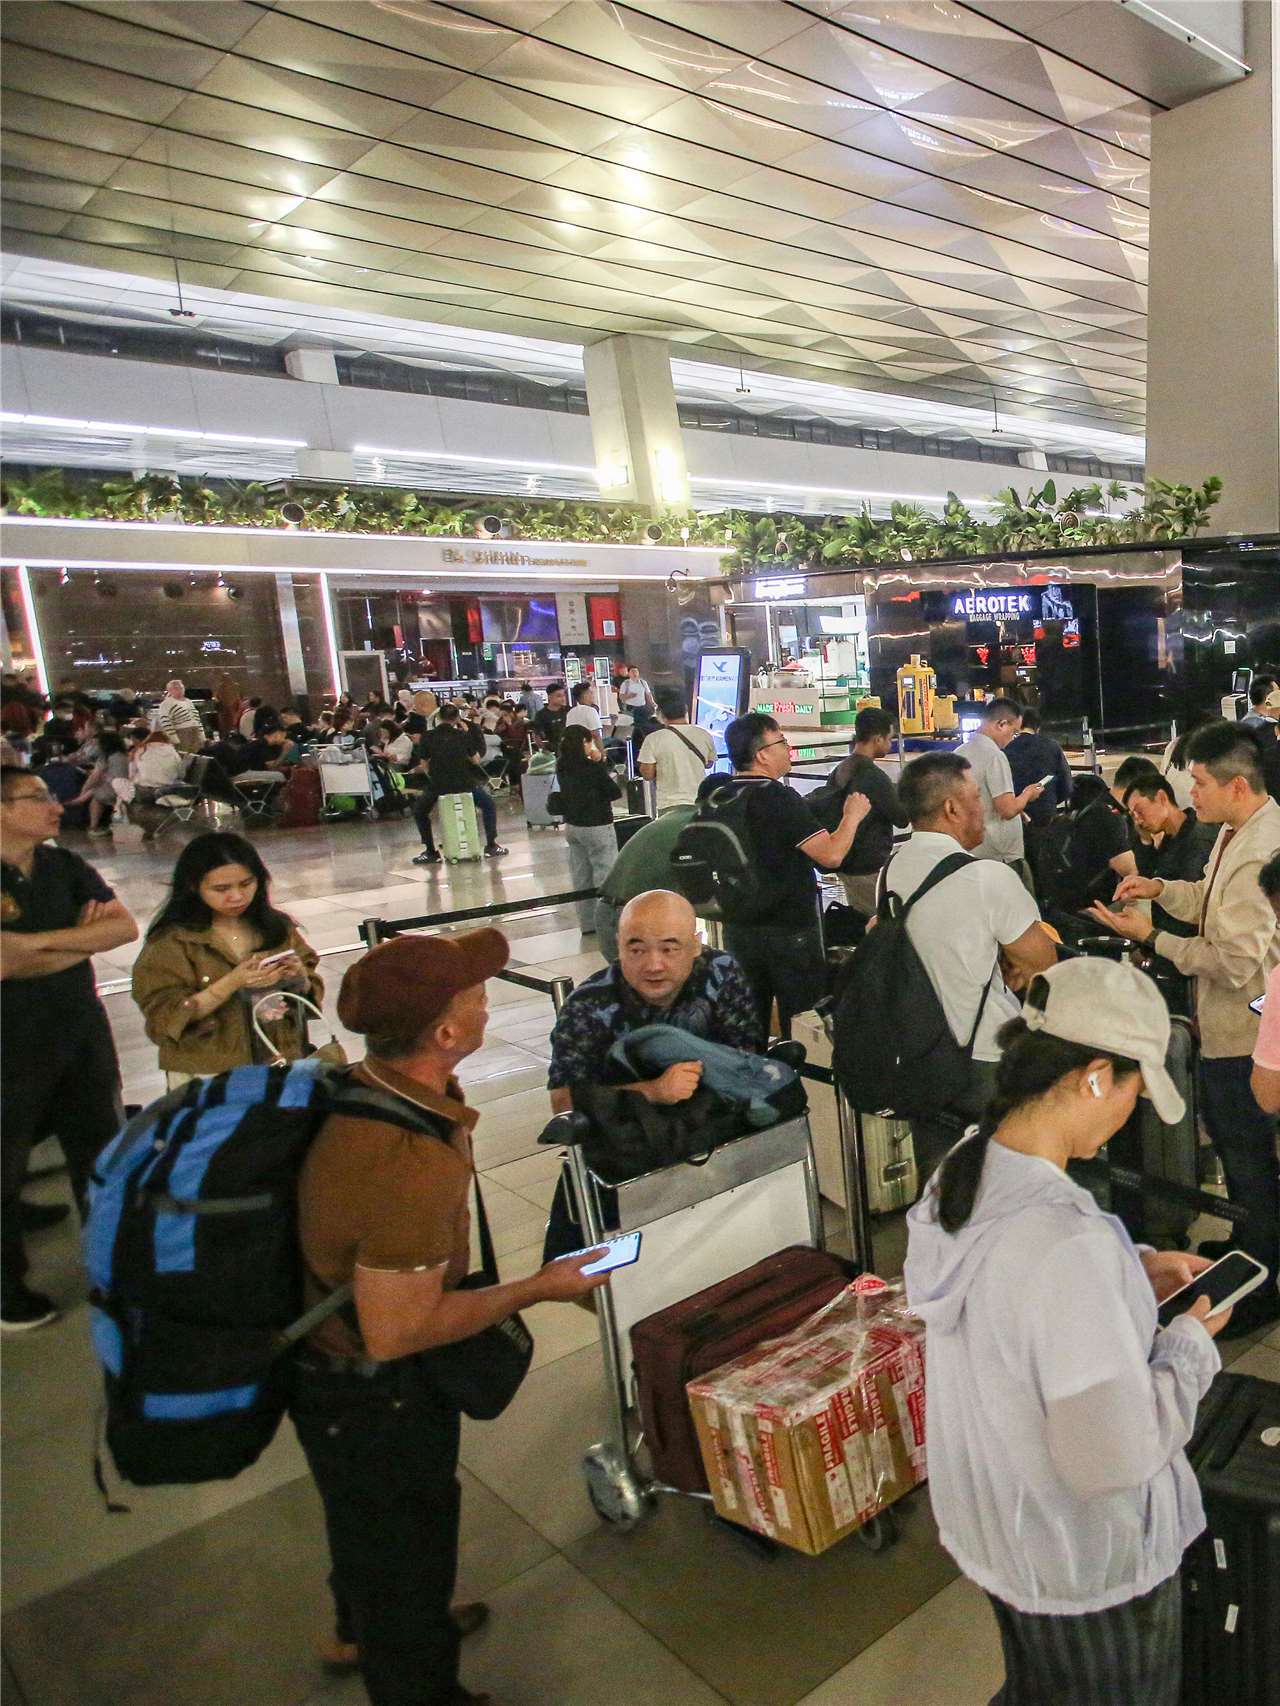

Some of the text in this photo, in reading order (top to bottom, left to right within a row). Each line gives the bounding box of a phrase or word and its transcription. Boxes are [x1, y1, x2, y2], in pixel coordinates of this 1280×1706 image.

[954, 595, 1030, 614] AEROTEK
[969, 612, 1020, 622] BAGGAGE WRAPPING
[757, 701, 813, 714] MADE Fresh DAILY
